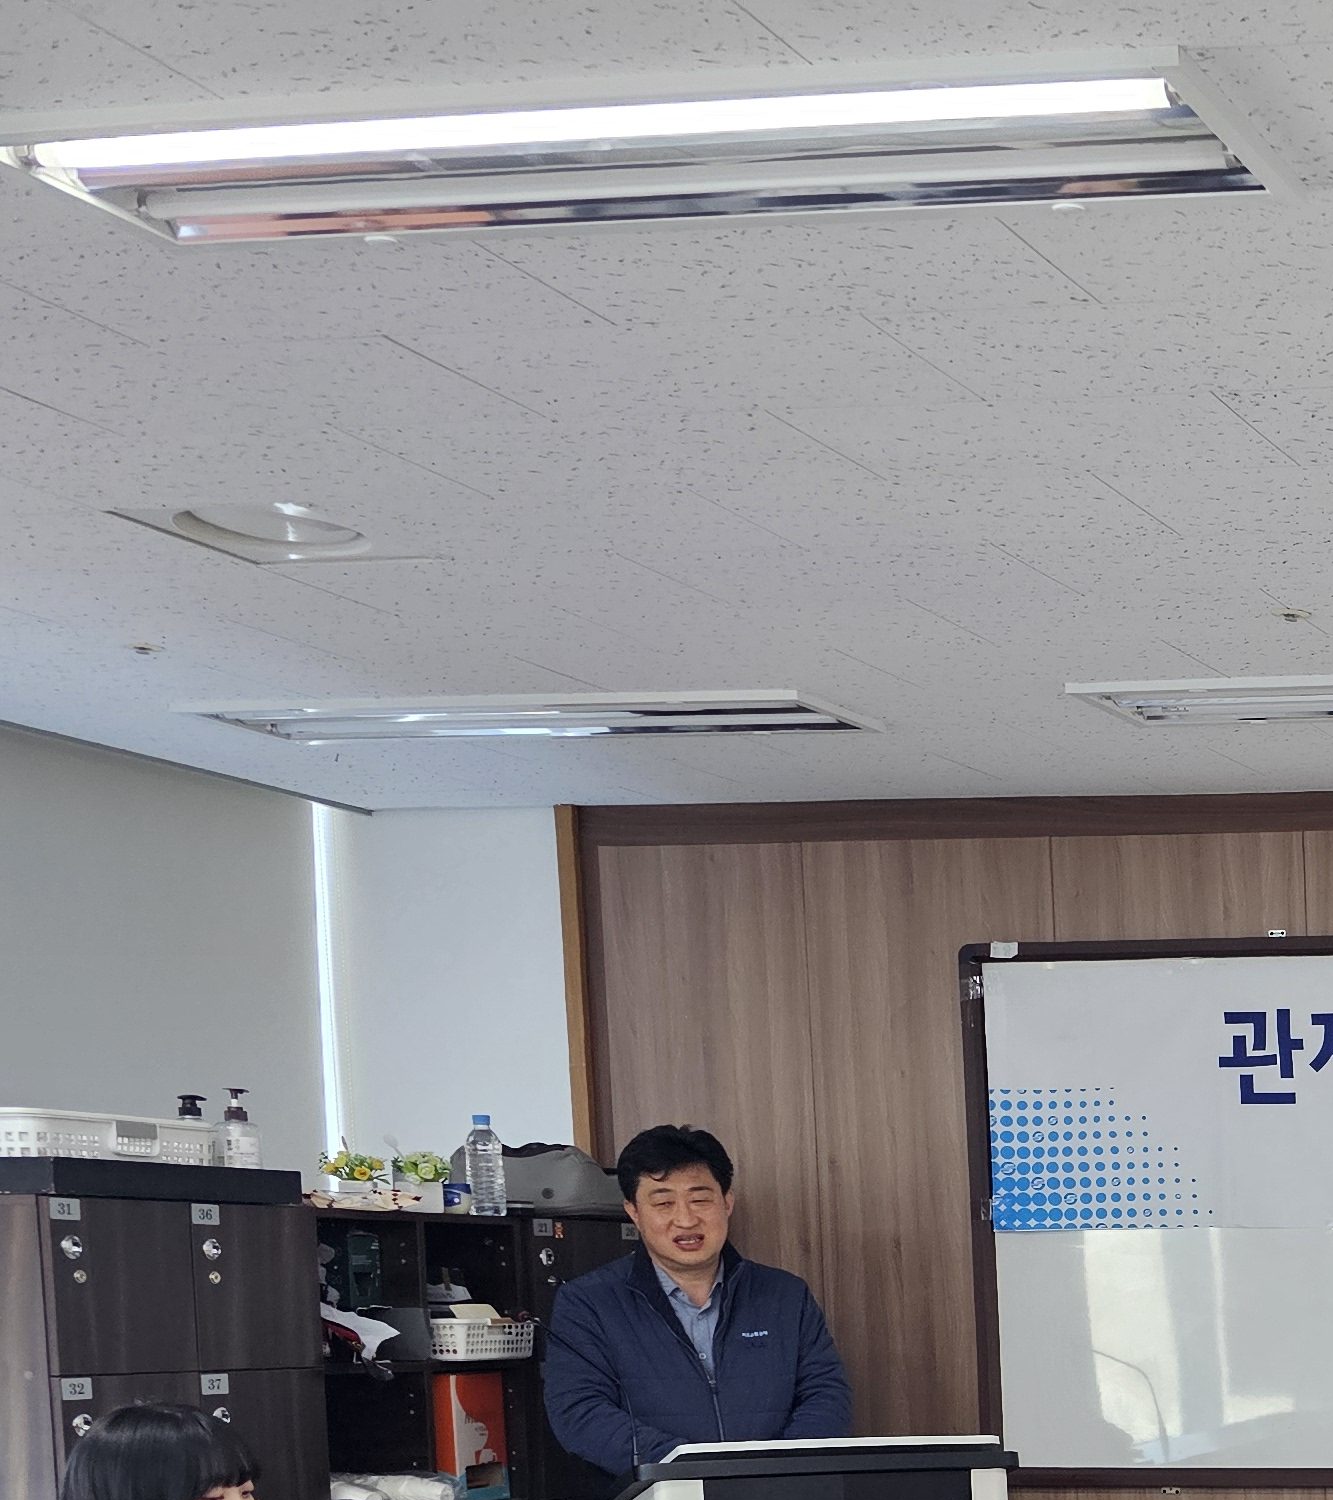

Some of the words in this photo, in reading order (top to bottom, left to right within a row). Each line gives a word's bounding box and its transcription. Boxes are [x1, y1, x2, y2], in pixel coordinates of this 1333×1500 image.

[57, 1202, 73, 1216] 31
[198, 1208, 213, 1221] 36
[69, 1382, 86, 1396] 32
[208, 1378, 222, 1391] 37
